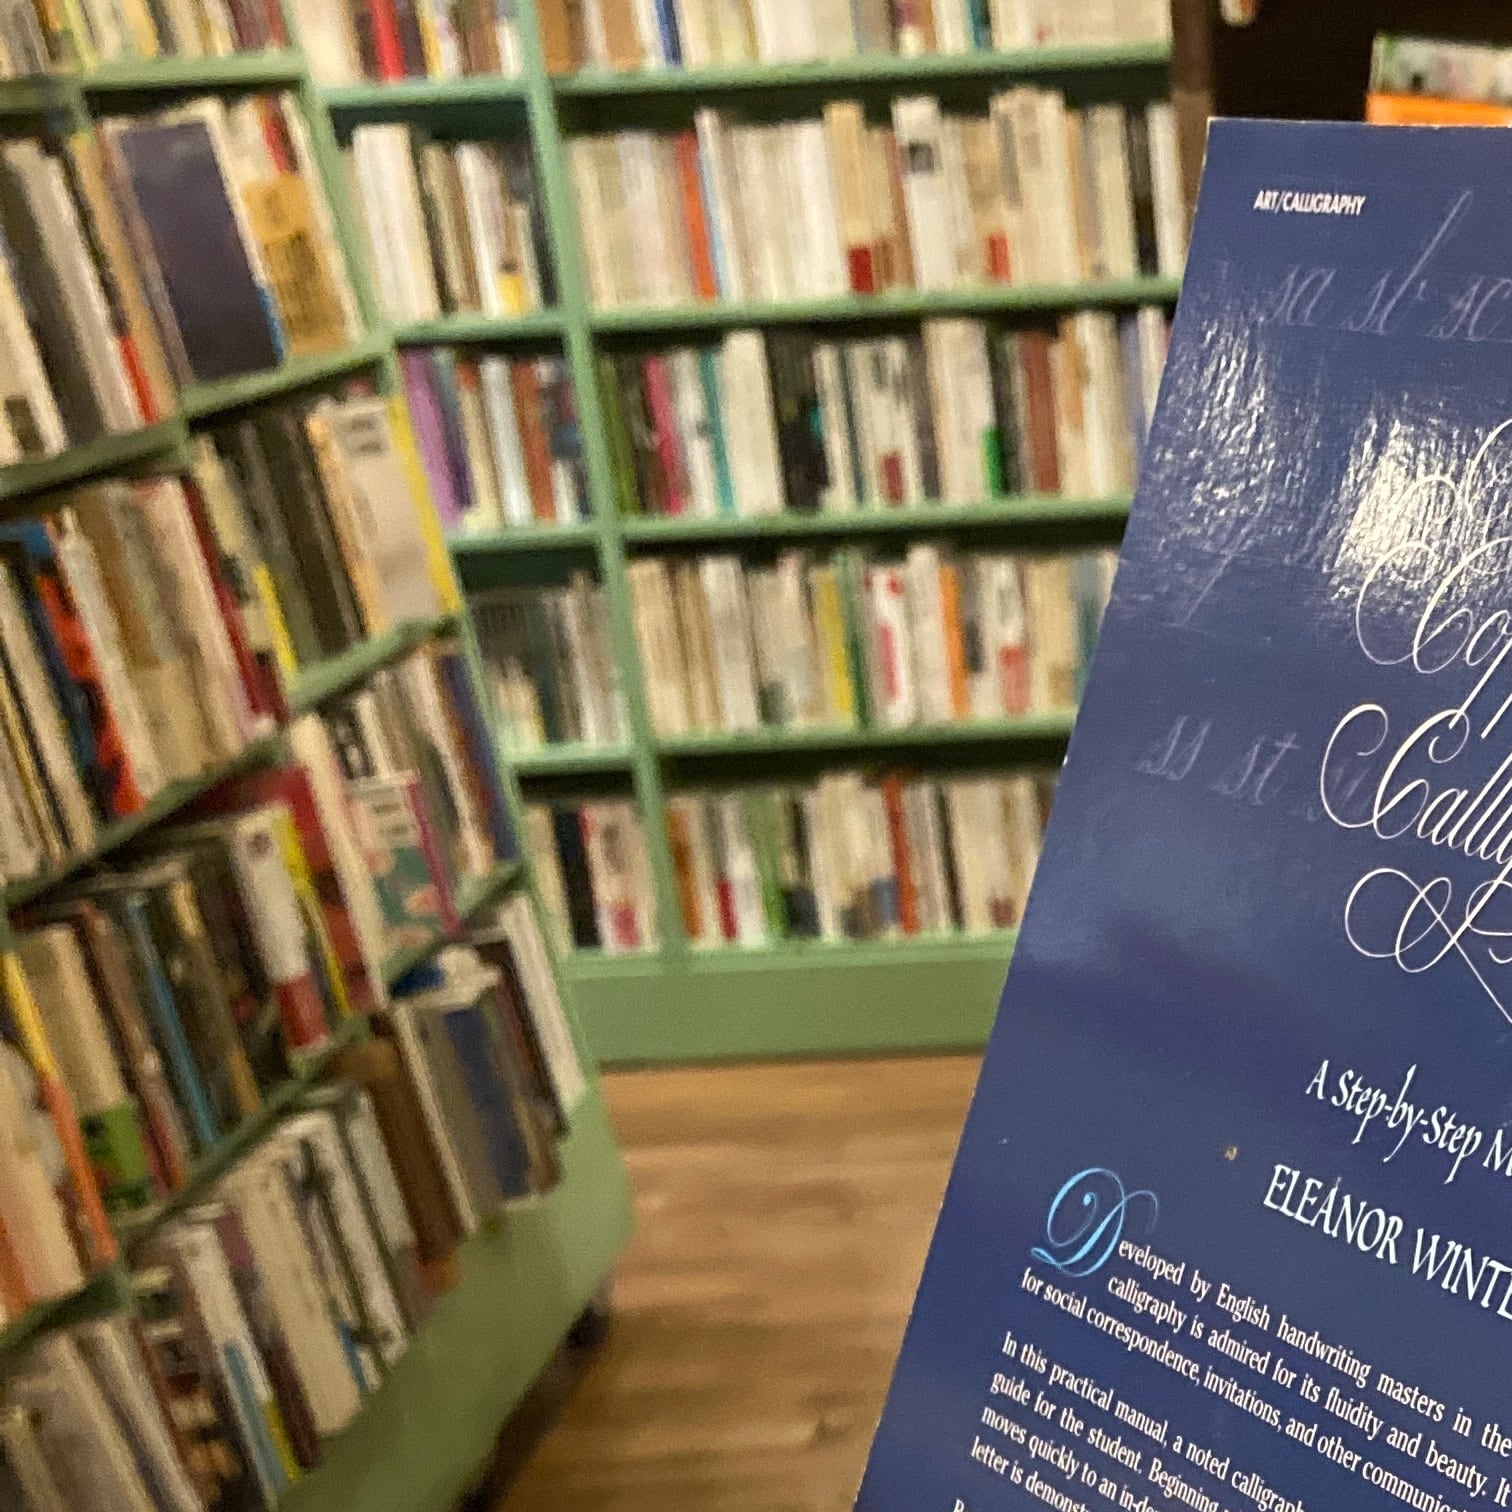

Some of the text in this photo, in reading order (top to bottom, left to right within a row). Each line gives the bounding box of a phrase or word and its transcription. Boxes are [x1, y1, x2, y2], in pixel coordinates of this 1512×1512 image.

[1254, 190, 1366, 216] ART/CALLIGRAPHY
[1305, 1059, 1330, 1101] A
[1331, 1063, 1482, 1185] Step-by-Step
[1262, 1163, 1404, 1264] ELEANOR
[1000, 1330, 1019, 1360] In
[1018, 1343, 1049, 1376] this
[1047, 1363, 1115, 1413] practical
[1112, 1400, 1170, 1449] manual,
[1171, 1435, 1184, 1456] a
[1184, 1442, 1232, 1483] noted
[1020, 1266, 1045, 1298] for
[1042, 1284, 1089, 1321] social
[1085, 1307, 1202, 1388] correspondence,
[1201, 1365, 1283, 1434] invitations,
[1283, 1417, 1320, 1450] and
[1315, 1435, 1363, 1474] other
[1106, 1276, 1189, 1336] calligraphy
[1188, 1314, 1206, 1341] is
[1206, 1329, 1272, 1377] admired
[1270, 1357, 1299, 1391] for
[1298, 1372, 1322, 1405] its
[1323, 1386, 1385, 1443] fluidity
[1384, 1426, 1424, 1460] and
[1423, 1439, 1490, 1500] beauty.
[1492, 1477, 1512, 1511] It
[1188, 1269, 1213, 1305] by
[1214, 1282, 1272, 1333] English
[1275, 1313, 1373, 1391] handwriting
[1375, 1373, 1447, 1424] masters
[1451, 1407, 1474, 1440] in
[969, 1435, 1011, 1477] letter
[1008, 1459, 1025, 1487] is
[988, 1372, 1032, 1408] guide
[1032, 1390, 1058, 1422] for
[1058, 1407, 1085, 1439] the
[1085, 1427, 1143, 1476] student.
